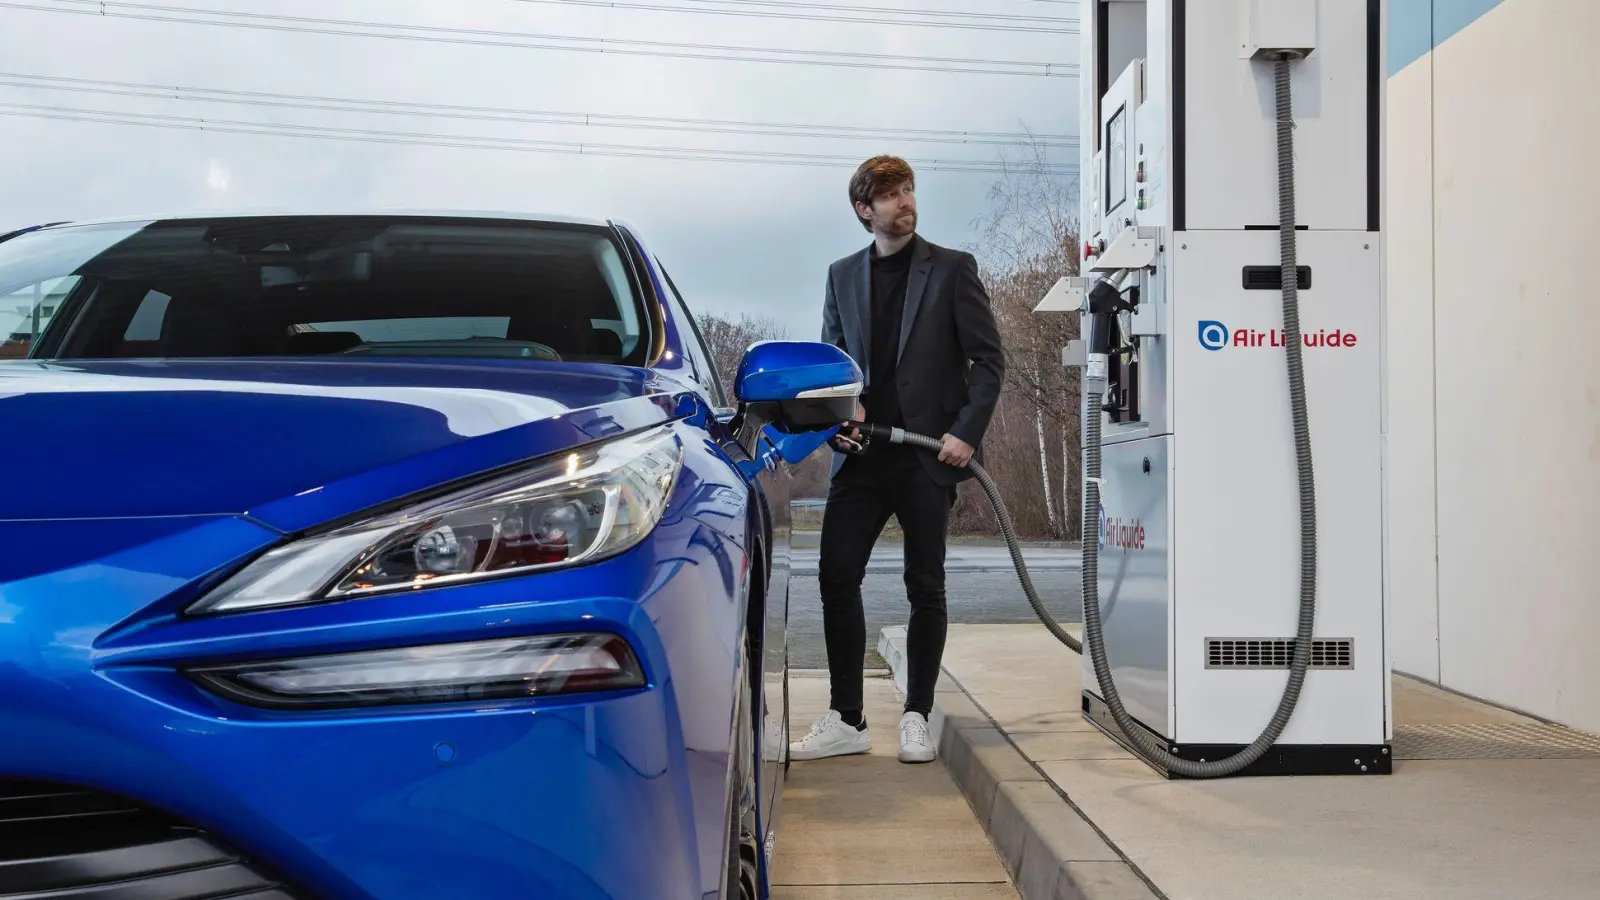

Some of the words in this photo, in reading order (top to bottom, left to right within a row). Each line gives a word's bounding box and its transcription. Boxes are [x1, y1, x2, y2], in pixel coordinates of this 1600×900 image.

[1233, 329, 1266, 347] Air
[1270, 329, 1357, 347] Liuide
[1106, 517, 1116, 546] Air
[1116, 517, 1145, 555] Liquide
